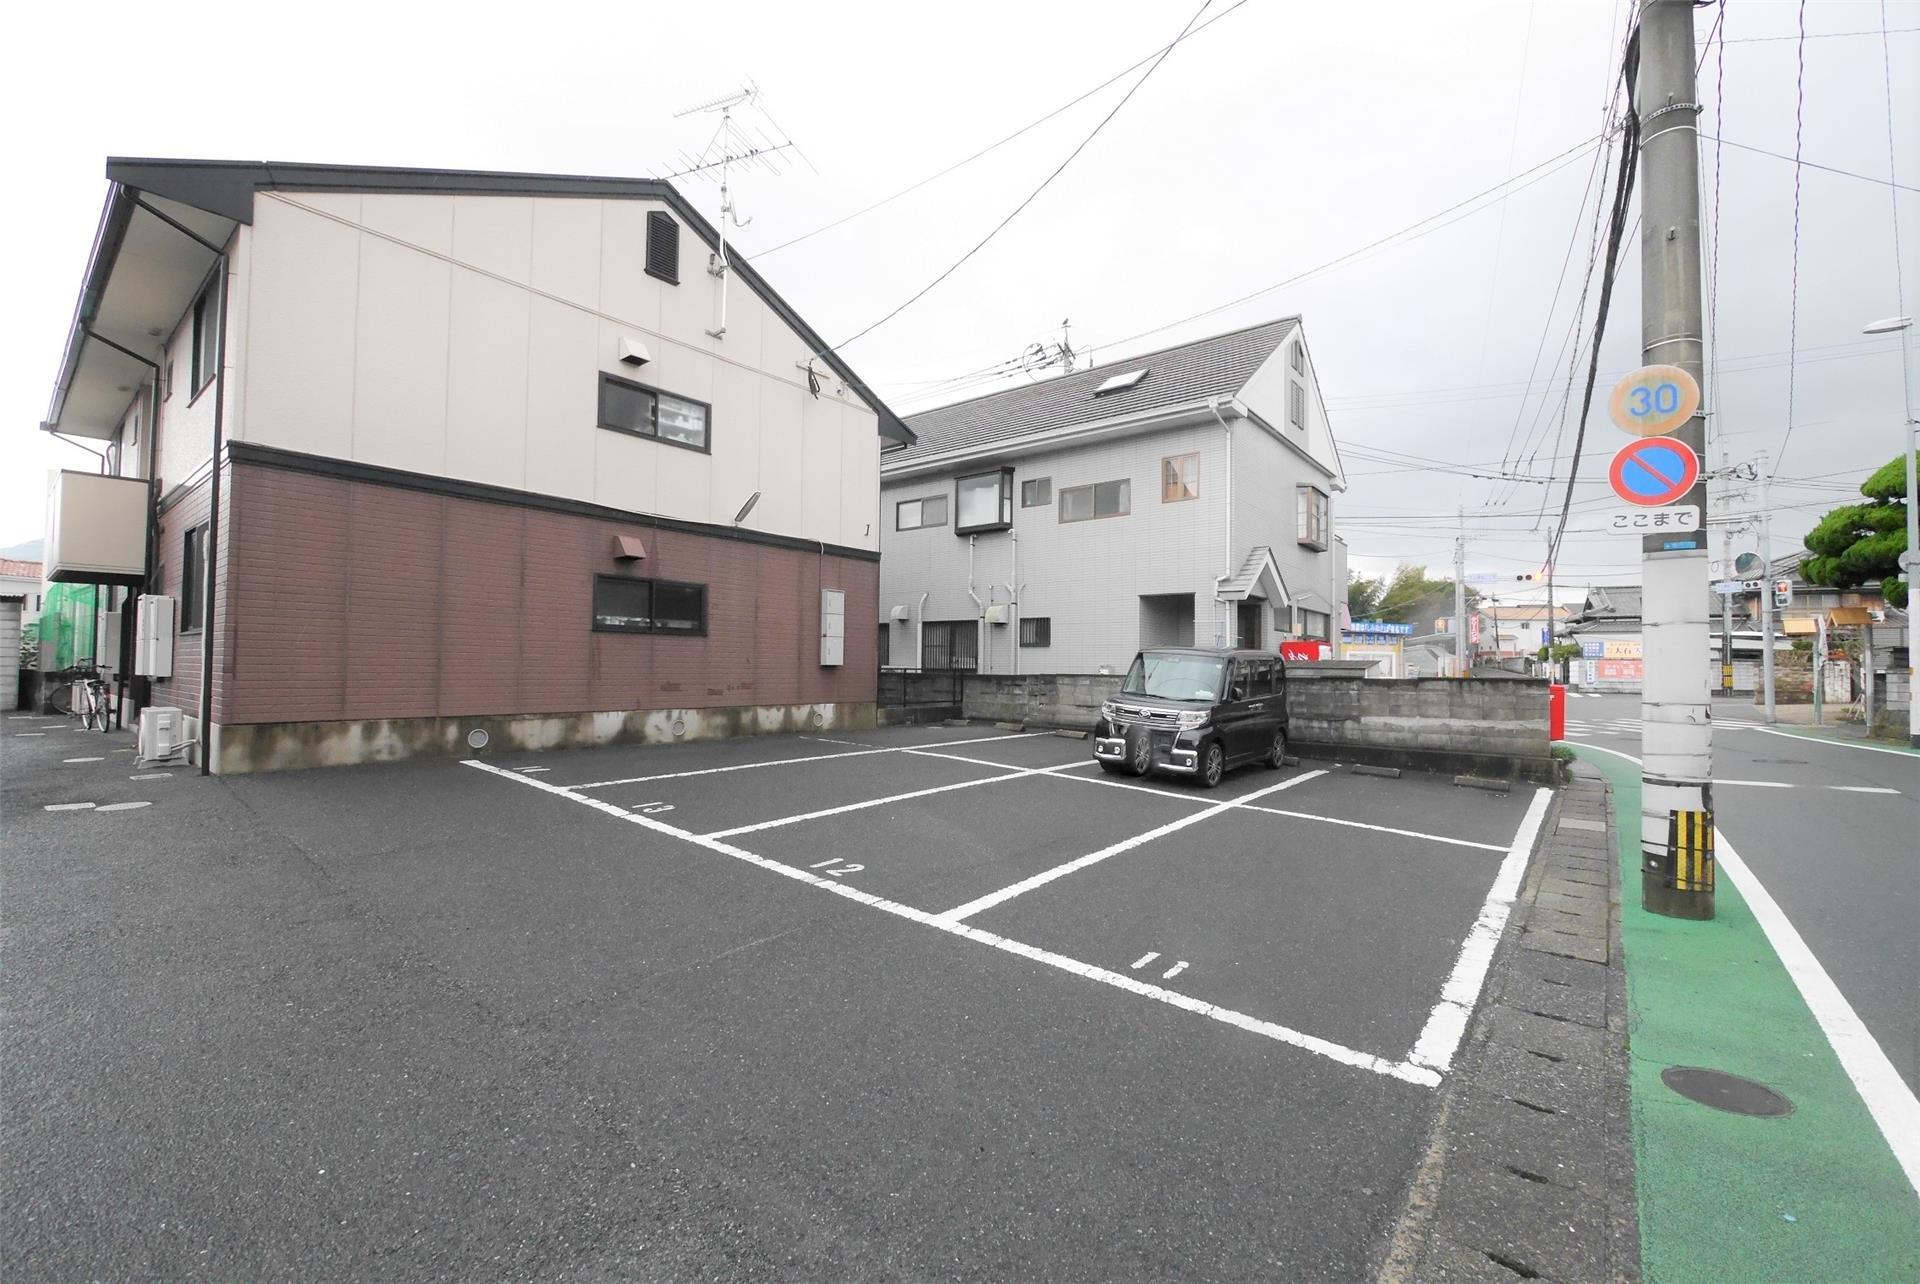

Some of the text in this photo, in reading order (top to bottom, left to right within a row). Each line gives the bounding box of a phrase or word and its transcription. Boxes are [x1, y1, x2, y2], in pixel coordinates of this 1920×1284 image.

[1630, 383, 1679, 417] 30
[1613, 511, 1693, 528] ここまで
[632, 802, 675, 813] 13
[809, 858, 864, 877] 12
[1130, 952, 1189, 979] 11
